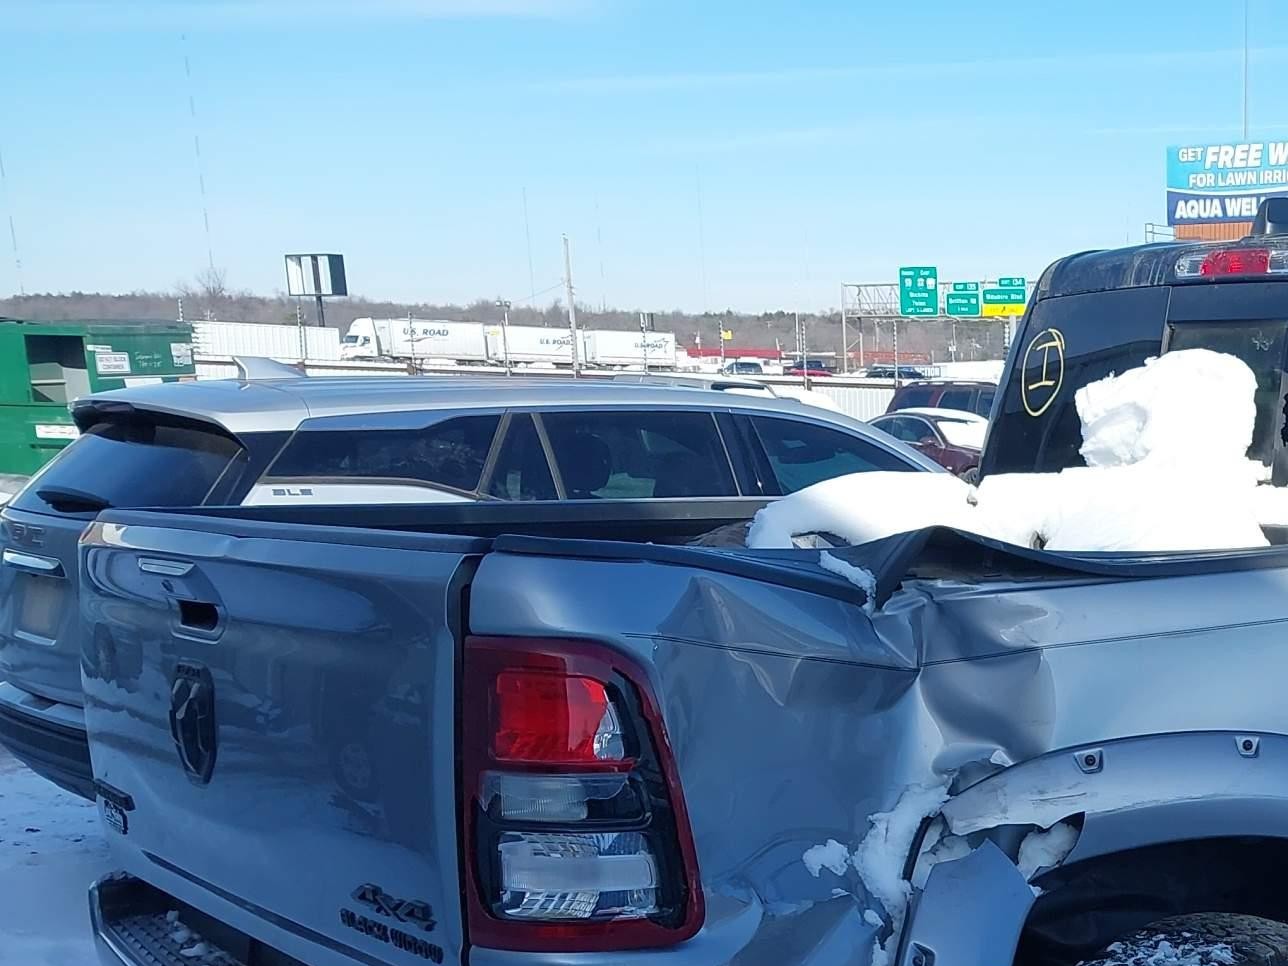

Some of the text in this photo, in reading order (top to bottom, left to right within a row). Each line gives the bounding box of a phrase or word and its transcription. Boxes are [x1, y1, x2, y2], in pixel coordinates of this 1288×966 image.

[1179, 148, 1204, 162] GET
[1205, 143, 1264, 169] FREE
[1189, 173, 1215, 188] FOR
[1217, 171, 1257, 186] LAWN
[1174, 199, 1223, 219] AQUA
[402, 328, 449, 337] U.S. ROAD
[340, 908, 444, 965] BLACK WIDOW
